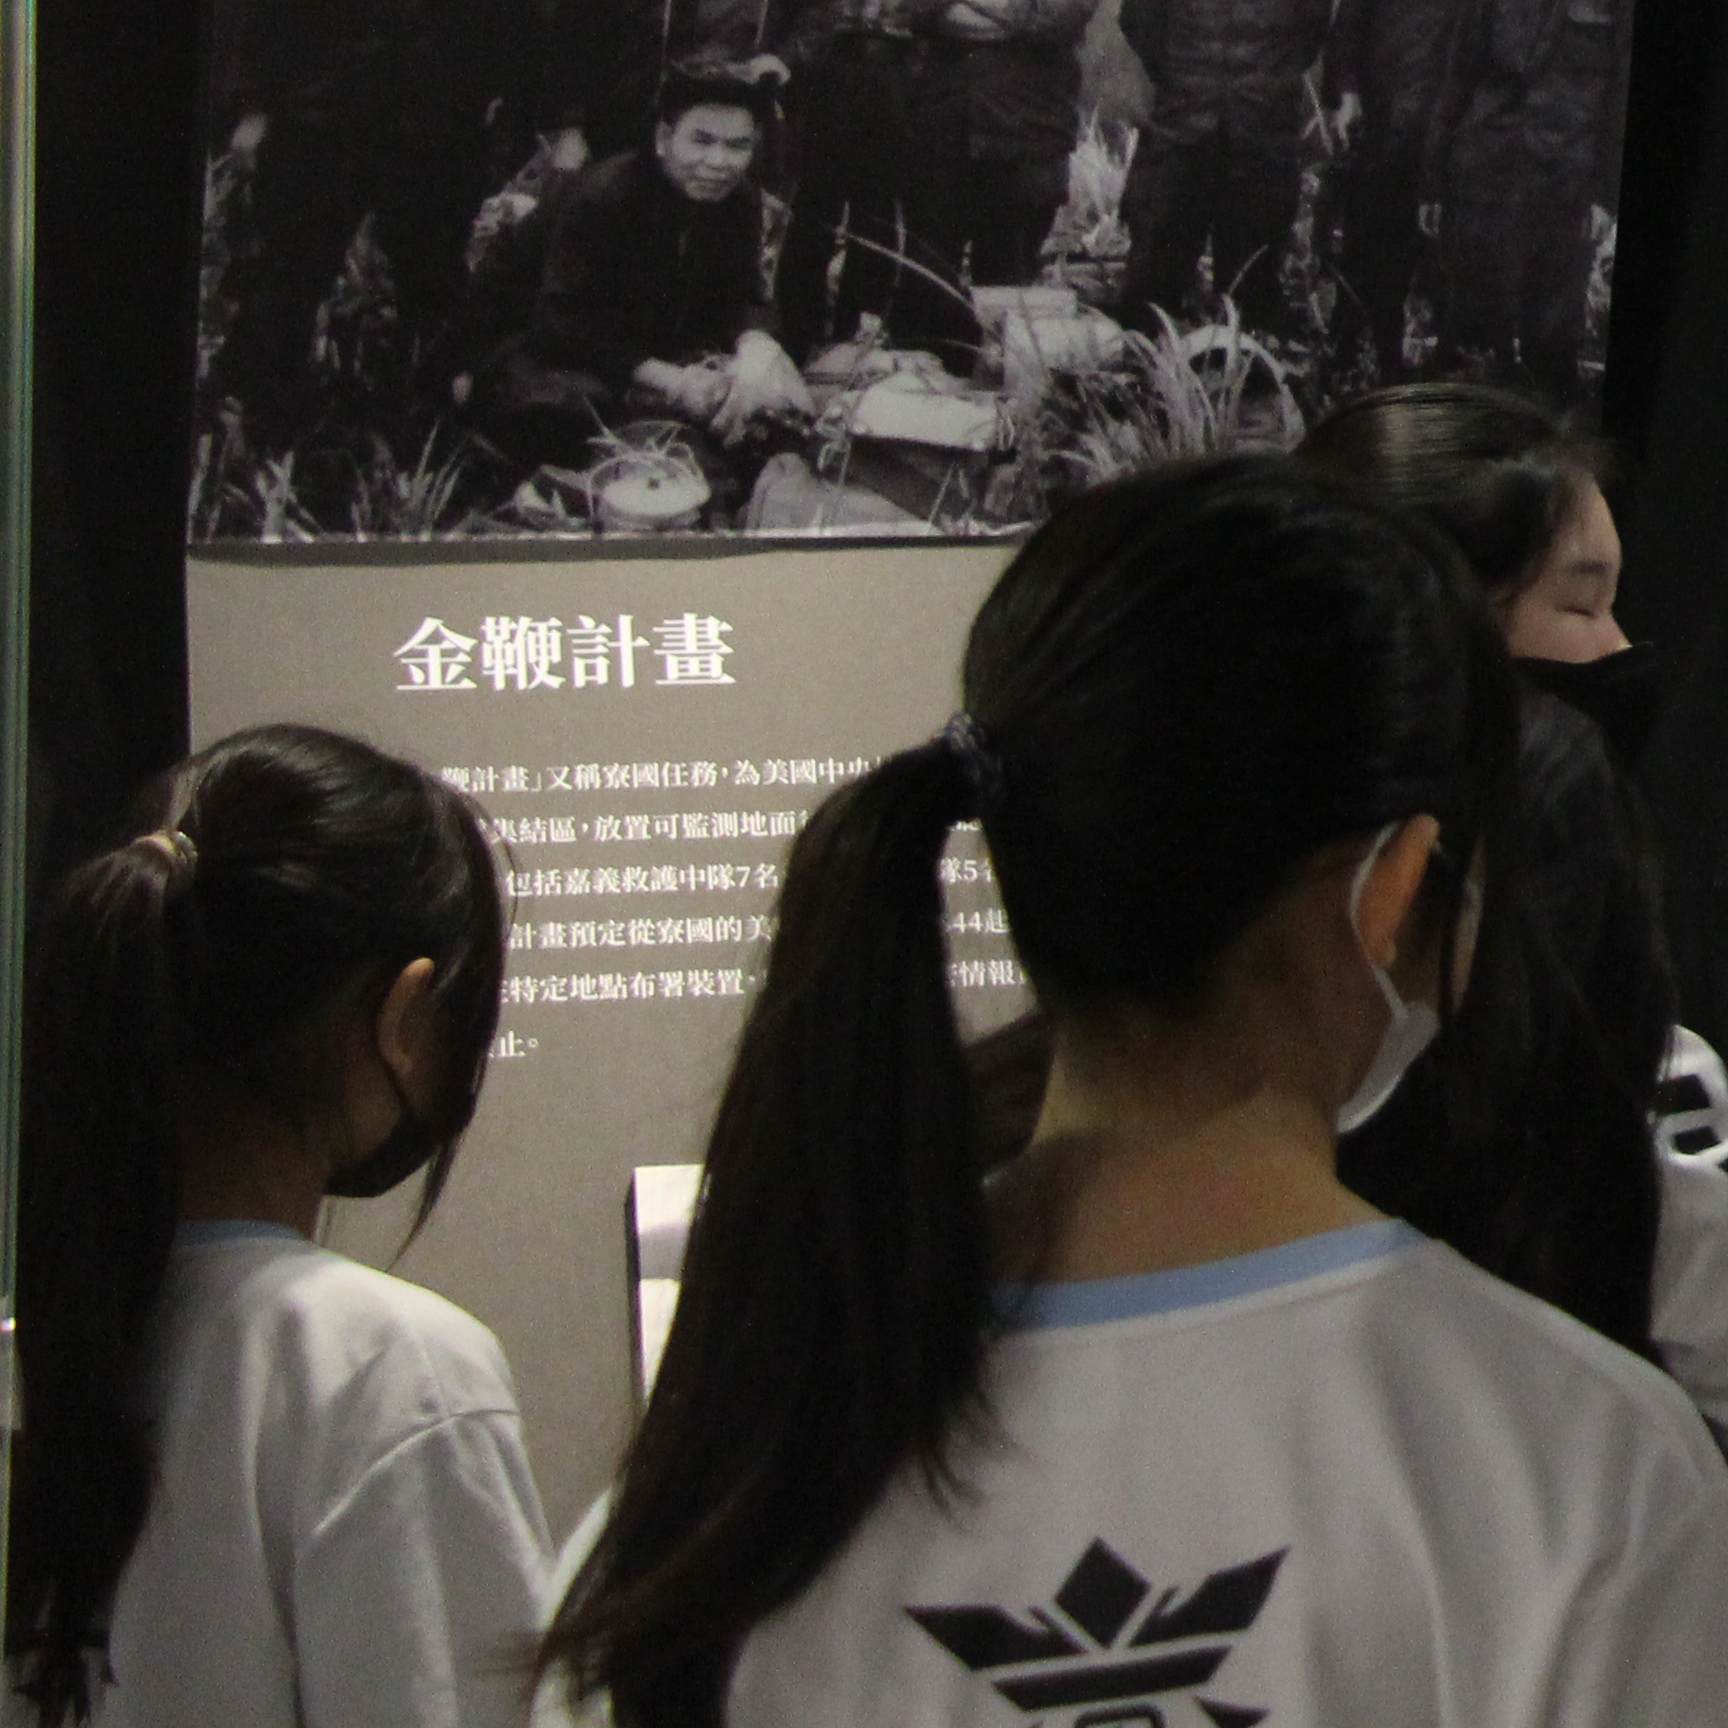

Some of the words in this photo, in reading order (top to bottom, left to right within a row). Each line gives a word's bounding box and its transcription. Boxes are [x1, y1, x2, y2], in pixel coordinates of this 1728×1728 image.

[394, 613, 736, 690] 金鞭計畫
[442, 756, 880, 792] 鞭計畫」又稱寮國任務，為美國中央
[478, 810, 808, 844] 集結區，放置可監測地面
[506, 863, 779, 898] 包括嘉義救護中隊7名
[510, 914, 779, 950] 計畫預定從寮國的美
[500, 968, 767, 1004] 特定地點布署裝置，
[951, 959, 1028, 988] 情報
[488, 1030, 539, 1059] 止。
